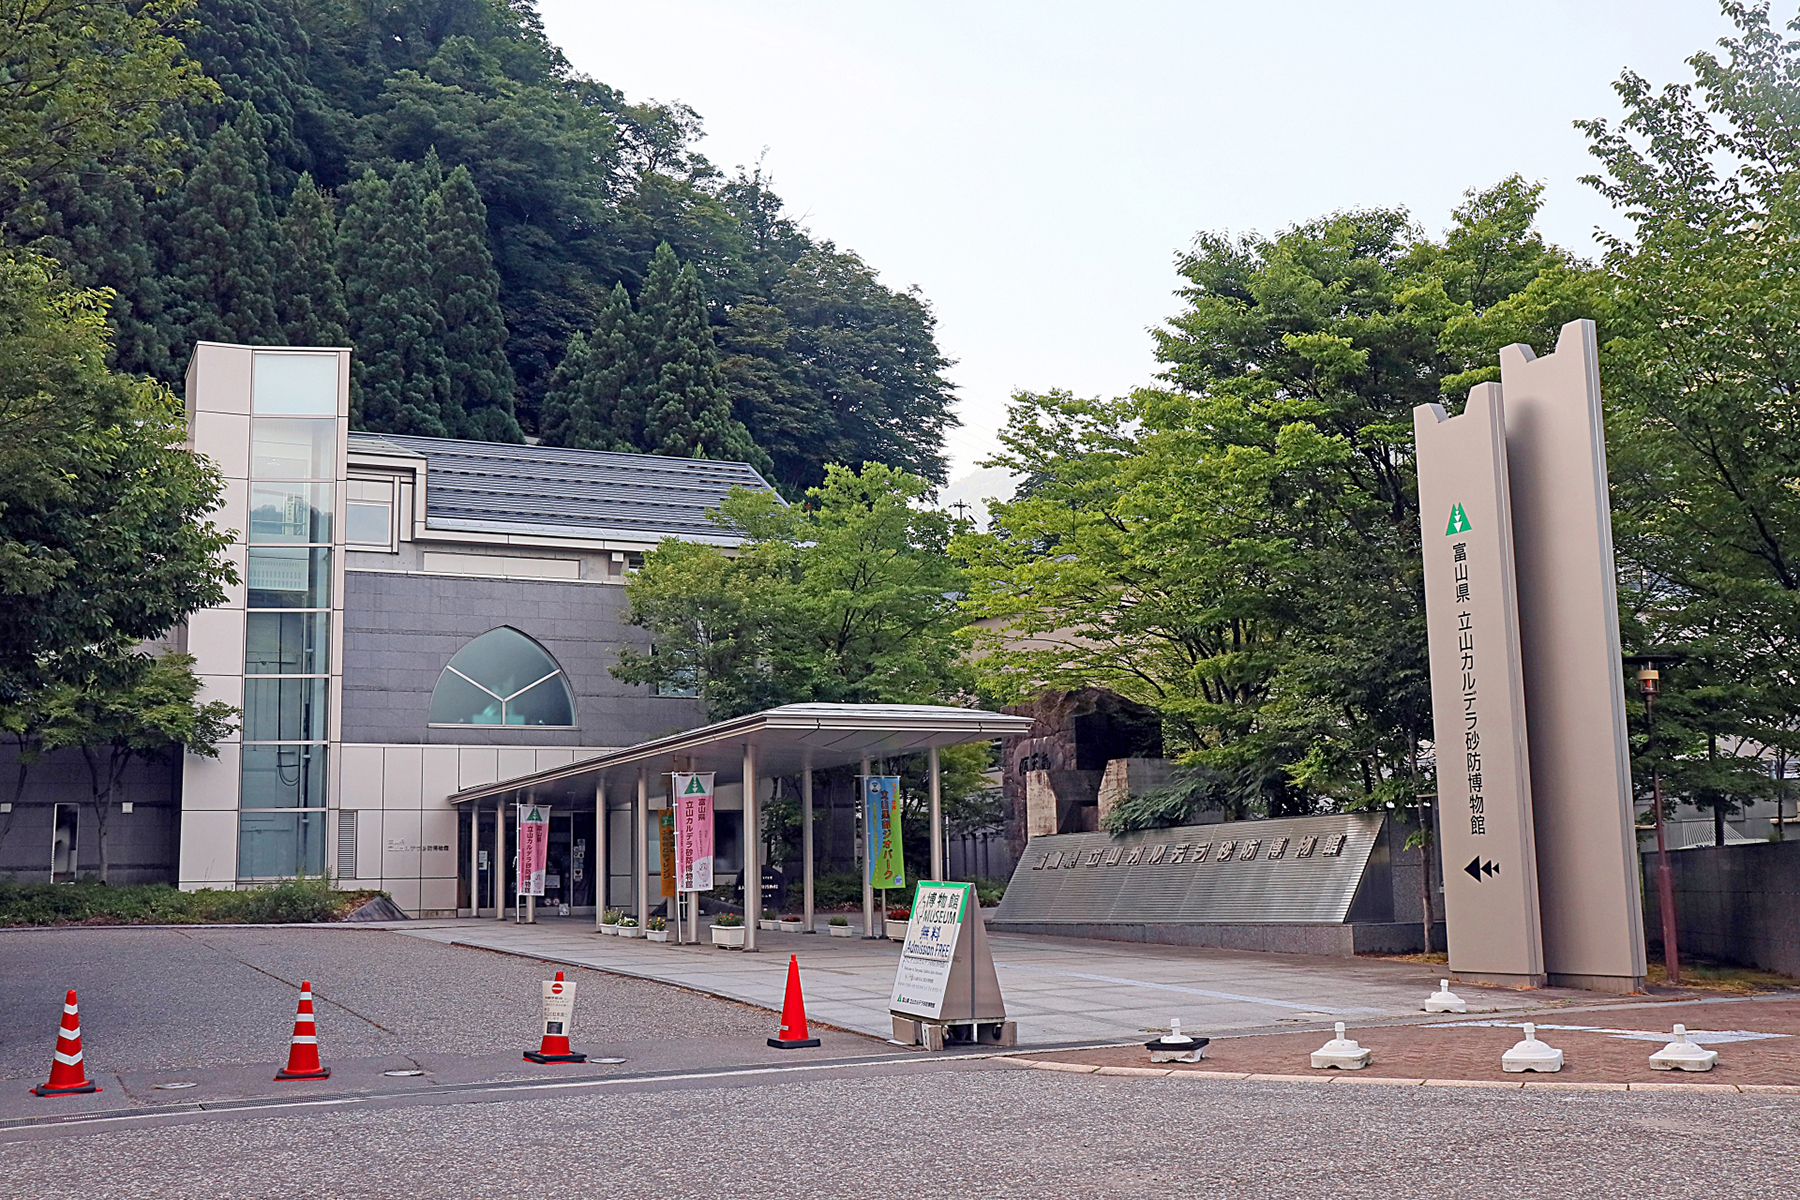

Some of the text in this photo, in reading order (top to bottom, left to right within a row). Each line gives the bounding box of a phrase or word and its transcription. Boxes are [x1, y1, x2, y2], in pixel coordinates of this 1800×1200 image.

[1452, 542, 1486, 836] 富山県 立山カルデラ砂防博物館
[697, 798, 706, 821] 富山県
[685, 800, 694, 889] 立山カルデラ砂防博物館
[880, 789, 894, 880] 立山黒部ジオパーク
[926, 892, 960, 910] 博物館
[922, 910, 957, 925] MUSEUM
[920, 925, 942, 942] 無料
[907, 940, 950, 958] Admission FREE
